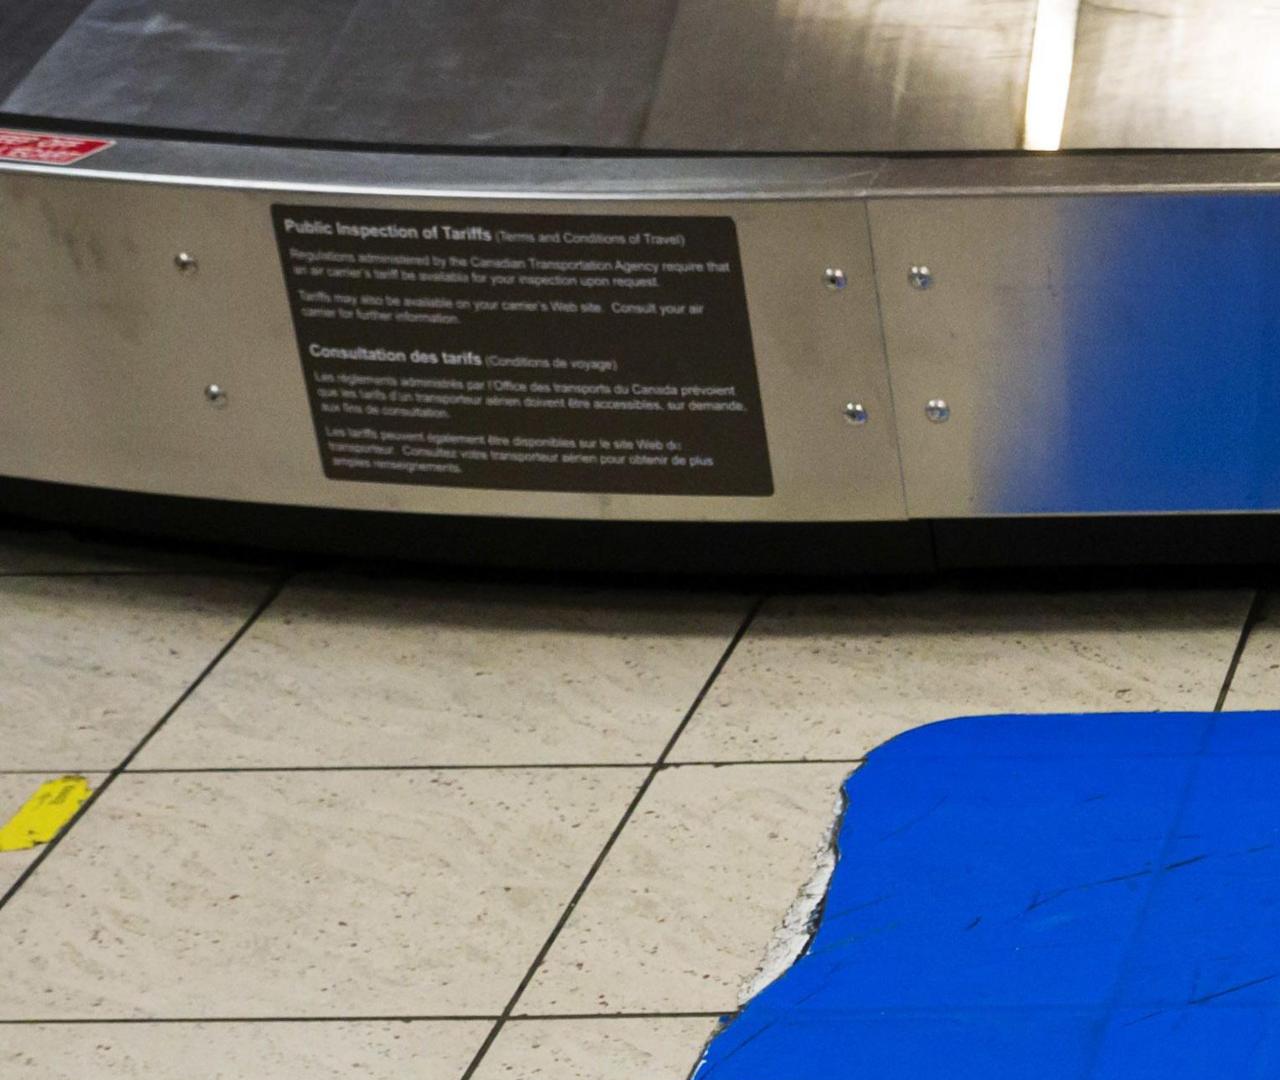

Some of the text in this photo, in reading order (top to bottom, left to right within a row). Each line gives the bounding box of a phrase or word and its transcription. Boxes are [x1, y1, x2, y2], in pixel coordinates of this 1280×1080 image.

[284, 218, 685, 247] Public Inspection of Tariffs (Terms and Conditions of Travel)
[432, 255, 446, 269] by
[470, 256, 526, 269] Canadian
[528, 257, 613, 272] Transportation
[615, 259, 659, 274] Agency
[662, 262, 703, 274] require
[706, 261, 730, 273] that
[490, 274, 515, 287] your
[518, 275, 577, 287] inspection
[580, 277, 610, 289] upon
[550, 301, 578, 313] Web
[611, 301, 656, 314] Consult
[659, 304, 685, 317] your
[689, 304, 703, 315] air
[309, 344, 406, 362] Consultation
[410, 349, 438, 365] des
[442, 351, 482, 366] tarifs
[553, 357, 567, 369] de
[571, 359, 617, 373] voyage)
[530, 382, 551, 393] des
[614, 384, 629, 395] du
[632, 383, 678, 396] Canada
[636, 439, 663, 451] Web
[672, 455, 686, 466] de
[689, 455, 714, 468] plus
